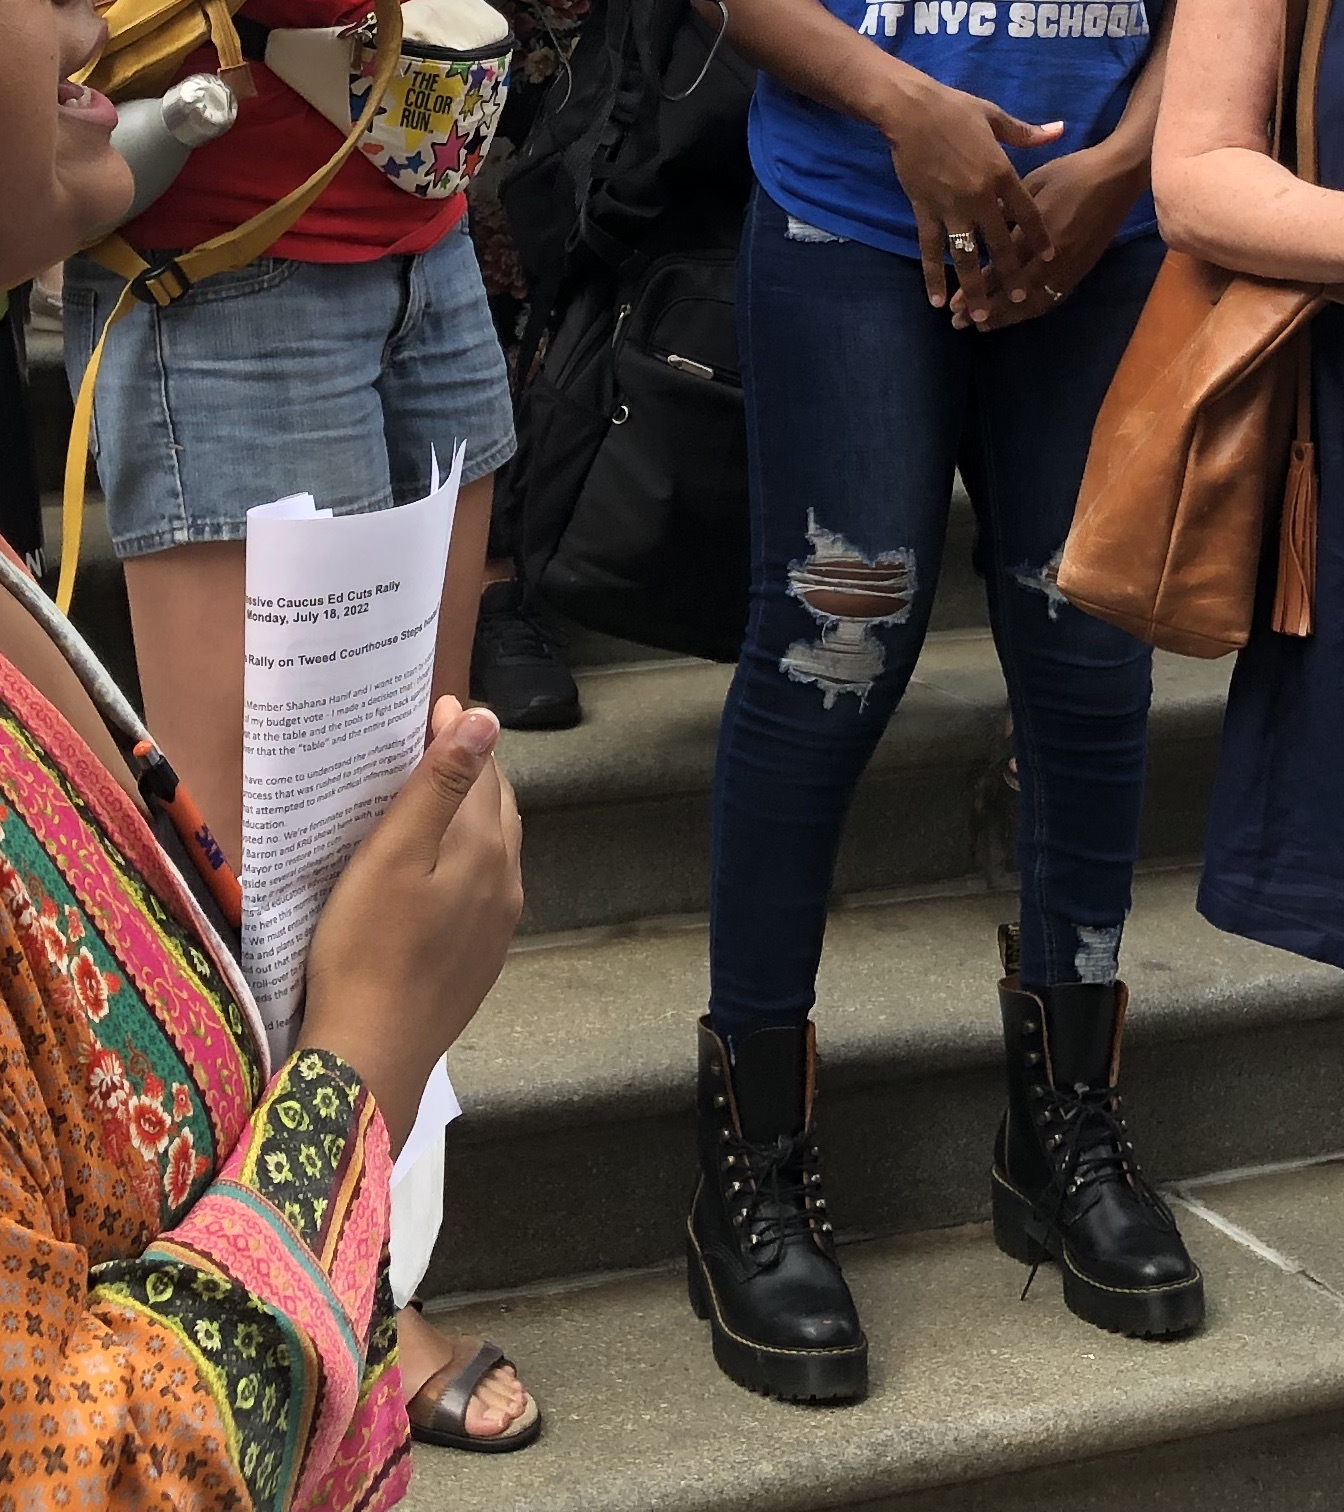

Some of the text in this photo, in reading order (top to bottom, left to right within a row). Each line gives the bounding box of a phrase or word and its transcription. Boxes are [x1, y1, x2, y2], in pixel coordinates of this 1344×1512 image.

[858, 1, 1149, 38] AT NYC SCHOOL
[412, 71, 439, 92] THE
[405, 88, 453, 114] COLOR
[400, 108, 432, 132] RUN
[276, 597, 324, 609] Caucus
[327, 593, 344, 605] Ed
[347, 589, 373, 602] Cuts
[375, 581, 401, 596] Rally
[247, 603, 369, 625] Monday, July 18, 2022
[248, 624, 422, 669] Rally on Tweed Courthouse Steps
[266, 712, 324, 728] budget vote
